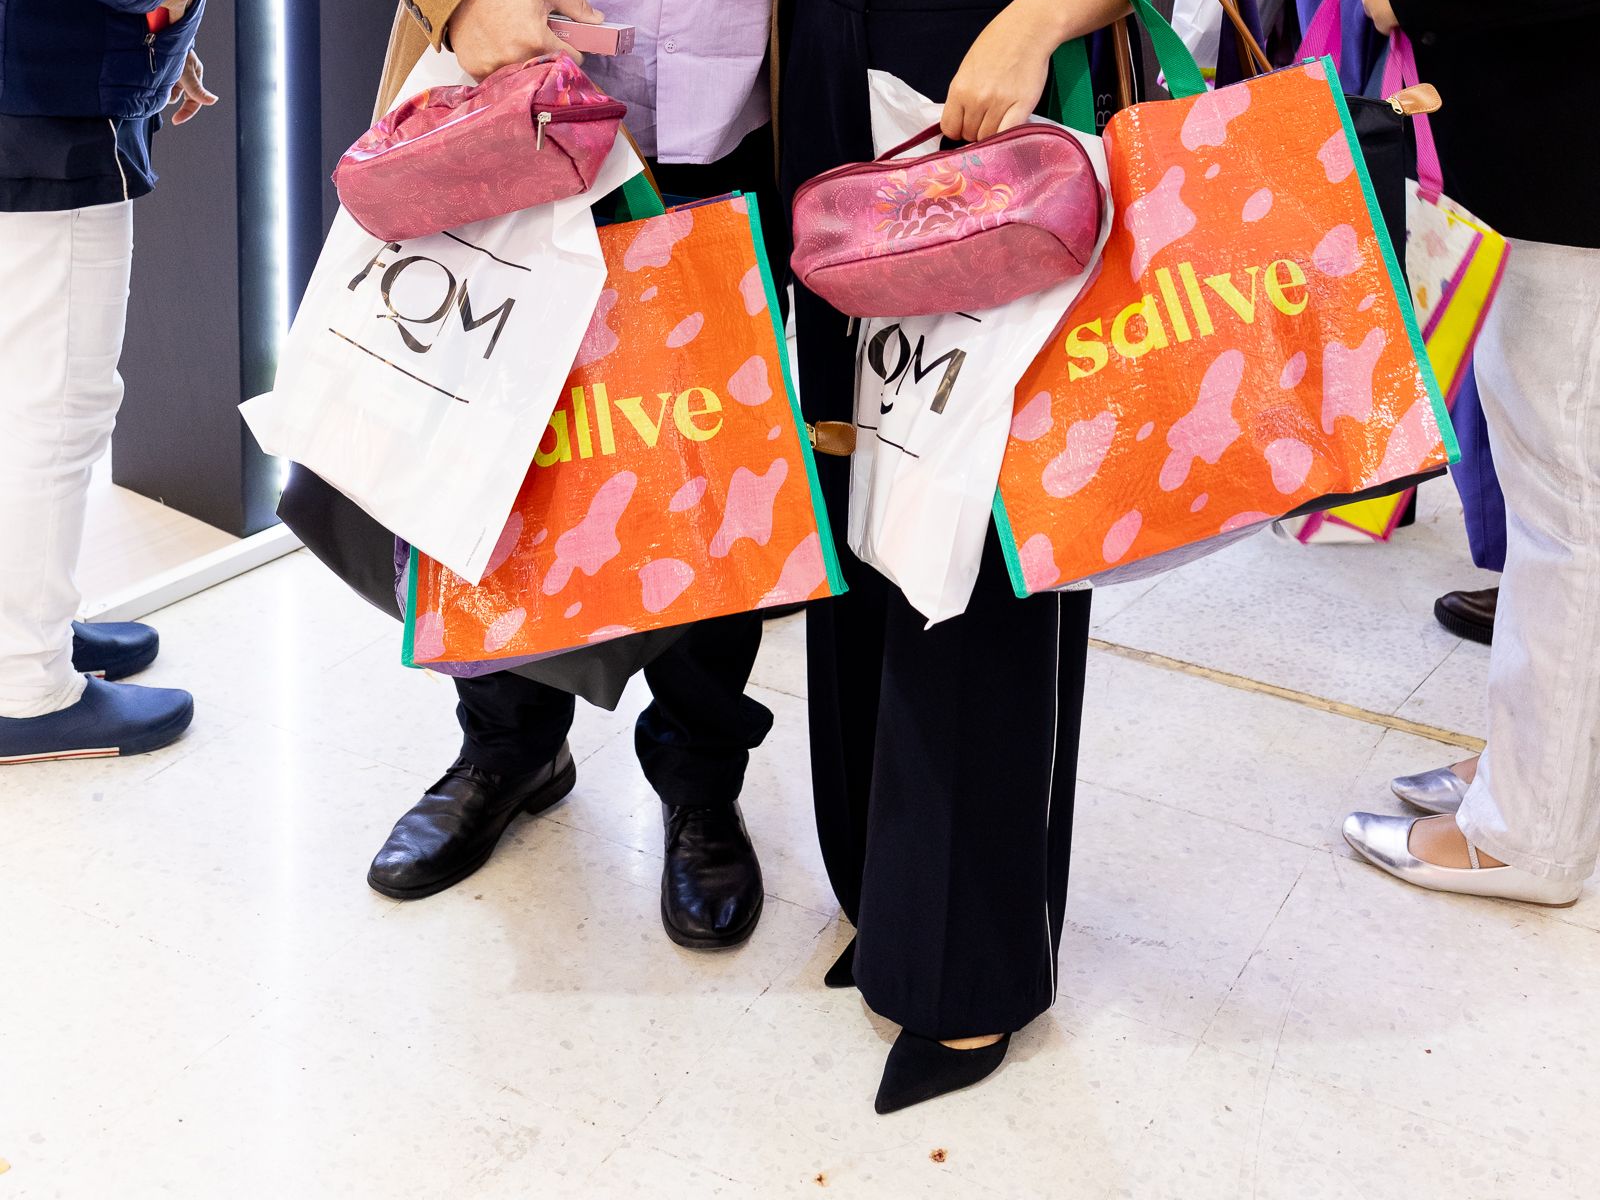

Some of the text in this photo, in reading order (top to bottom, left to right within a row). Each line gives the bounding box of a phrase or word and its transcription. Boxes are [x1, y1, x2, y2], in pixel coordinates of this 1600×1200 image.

[1065, 259, 1309, 383] sallve
[868, 323, 967, 415] QM
[533, 382, 724, 468] allve
